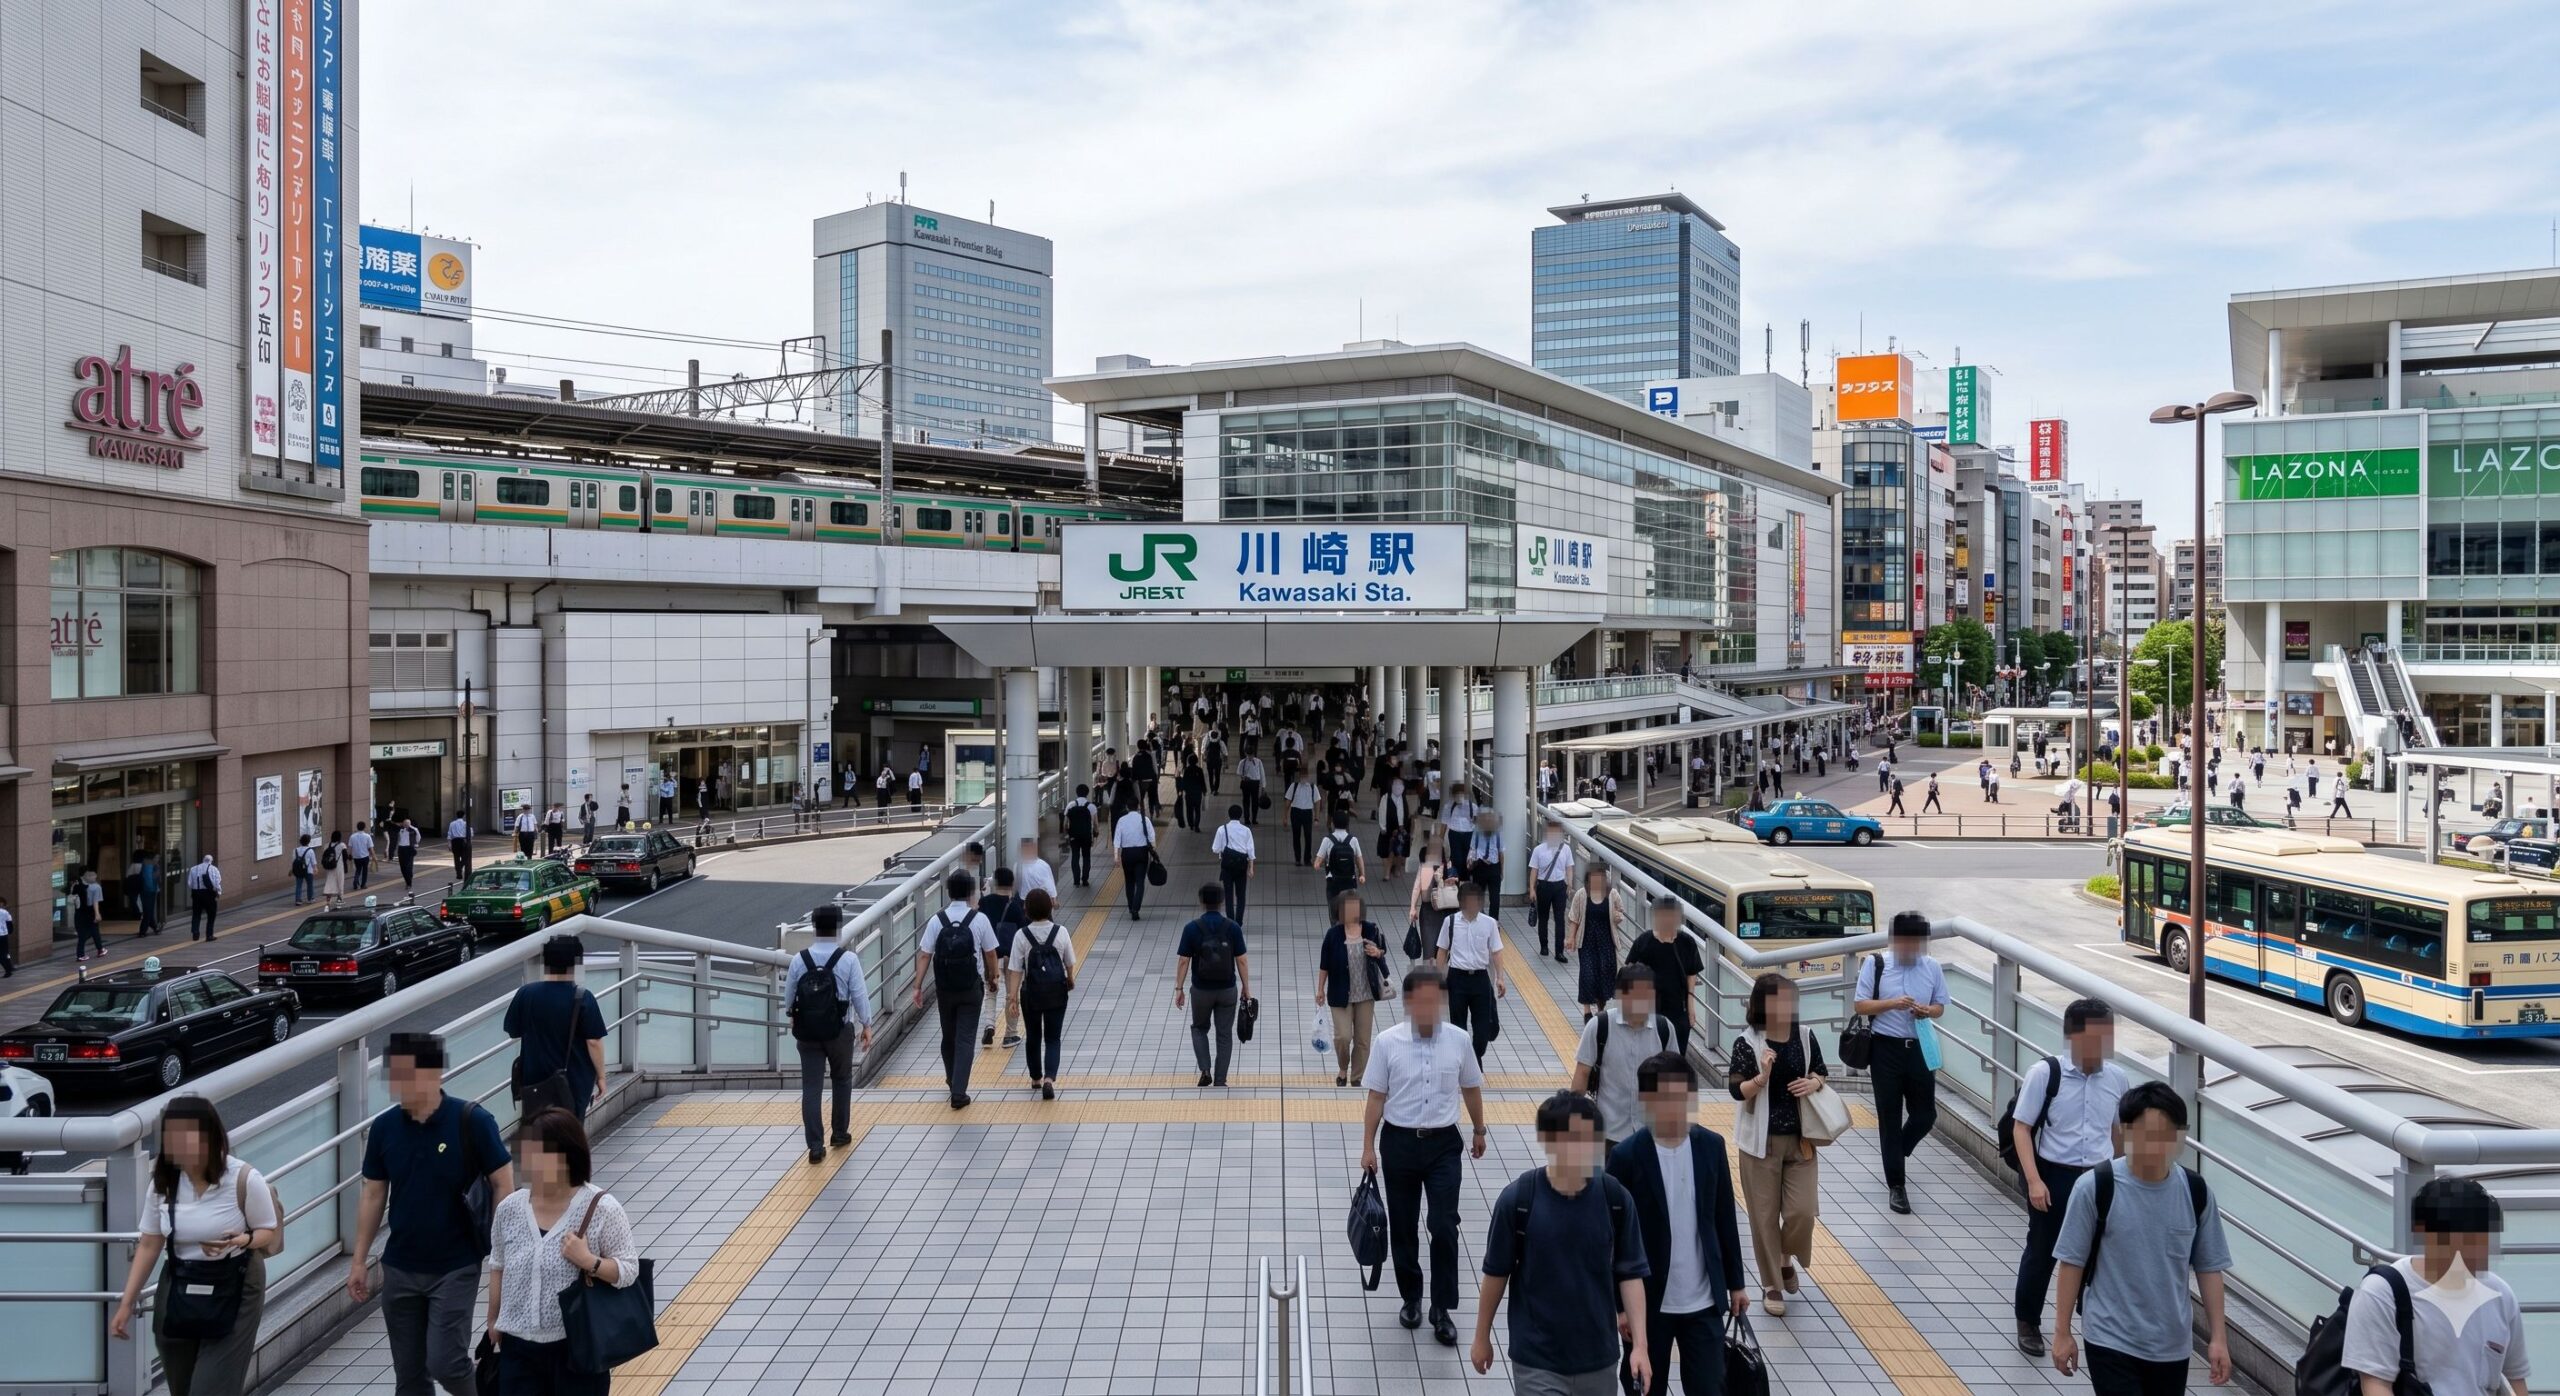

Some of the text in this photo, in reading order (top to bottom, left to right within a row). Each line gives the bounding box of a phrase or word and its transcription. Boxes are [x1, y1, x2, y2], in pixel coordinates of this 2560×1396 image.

[953, 237, 984, 253] Frontier
[985, 244, 1003, 259] Bldg
[72, 344, 204, 440] atré
[89, 436, 184, 468] KAWASAKI
[2251, 459, 2367, 481] LAZONA
[1109, 533, 1198, 582] JR
[1236, 531, 1415, 576] 川崎駅
[1528, 536, 1547, 566] JR
[1554, 538, 1592, 569] 川崎駅
[1239, 582, 1411, 602] Kawasaki Sta.
[51, 611, 103, 645] atré
